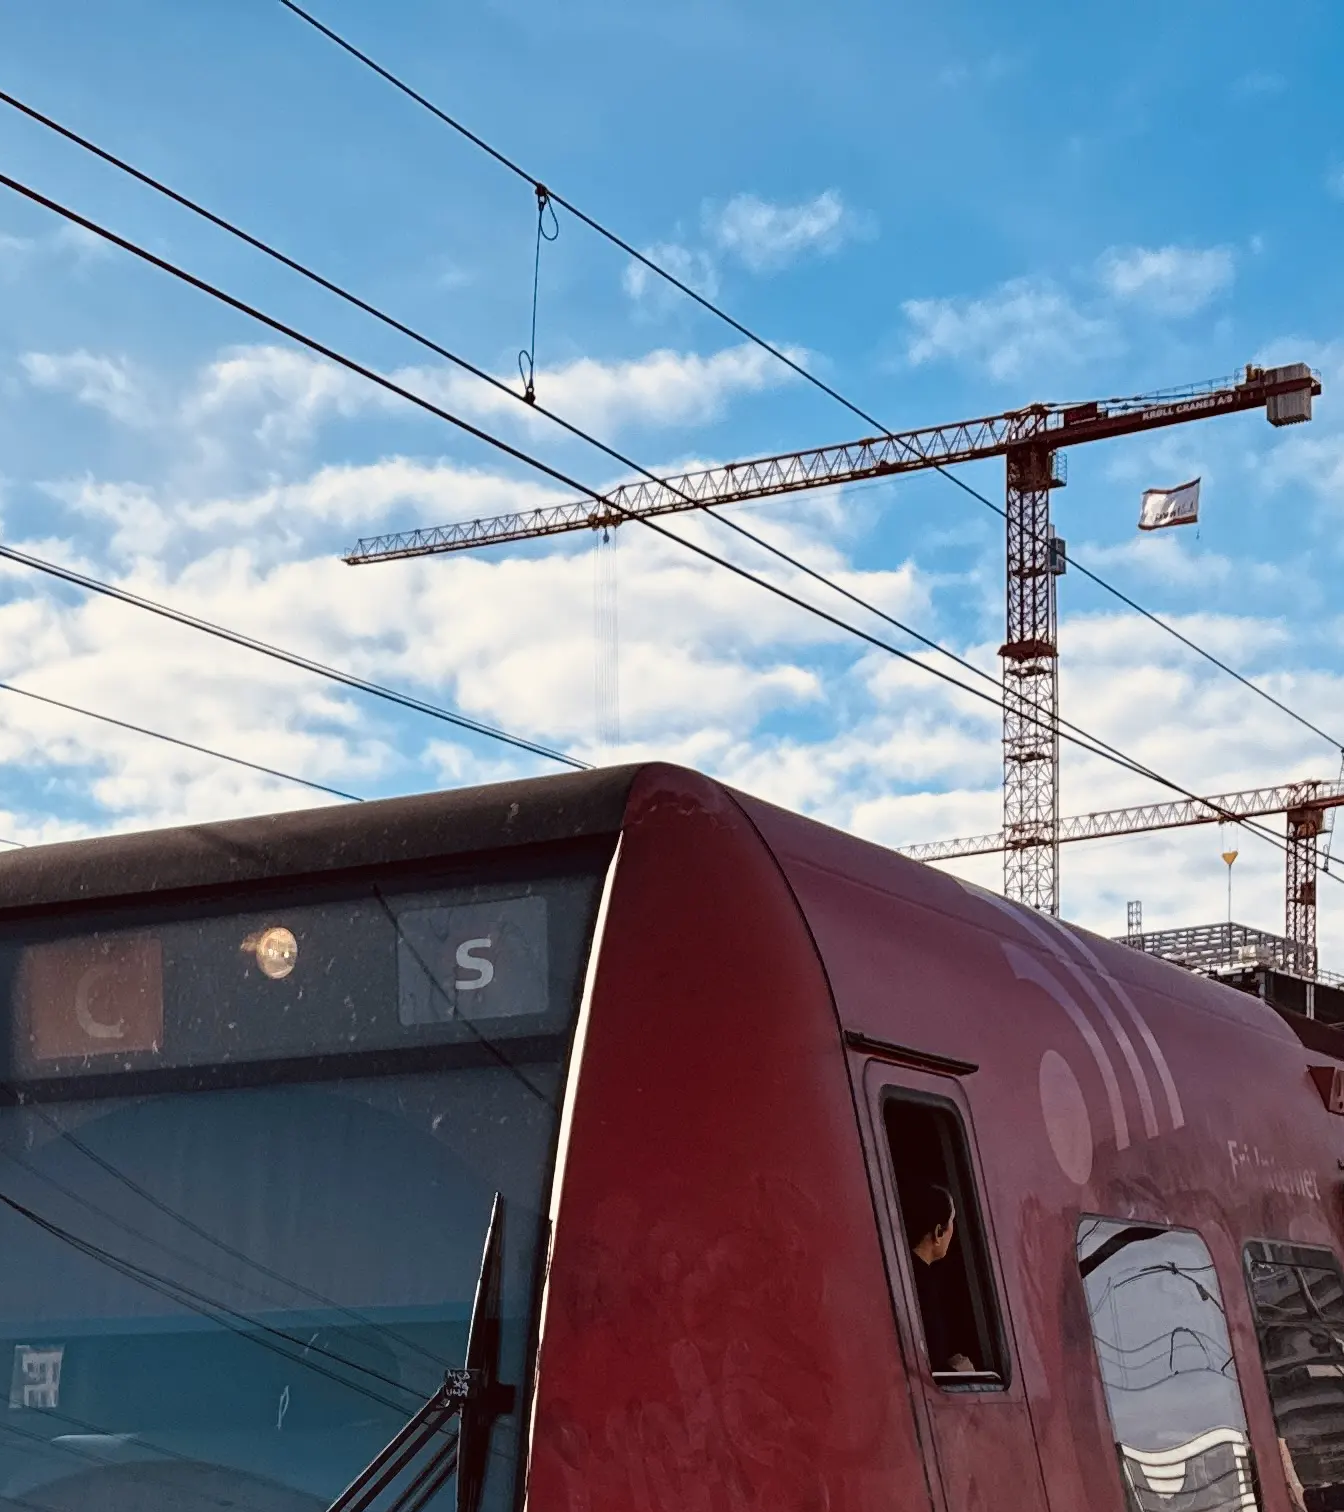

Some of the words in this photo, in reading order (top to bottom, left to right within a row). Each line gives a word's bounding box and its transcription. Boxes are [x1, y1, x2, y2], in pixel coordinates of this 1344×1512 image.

[1176, 398, 1216, 414] CRANES
[455, 937, 494, 990] S
[75, 965, 125, 1038] C
